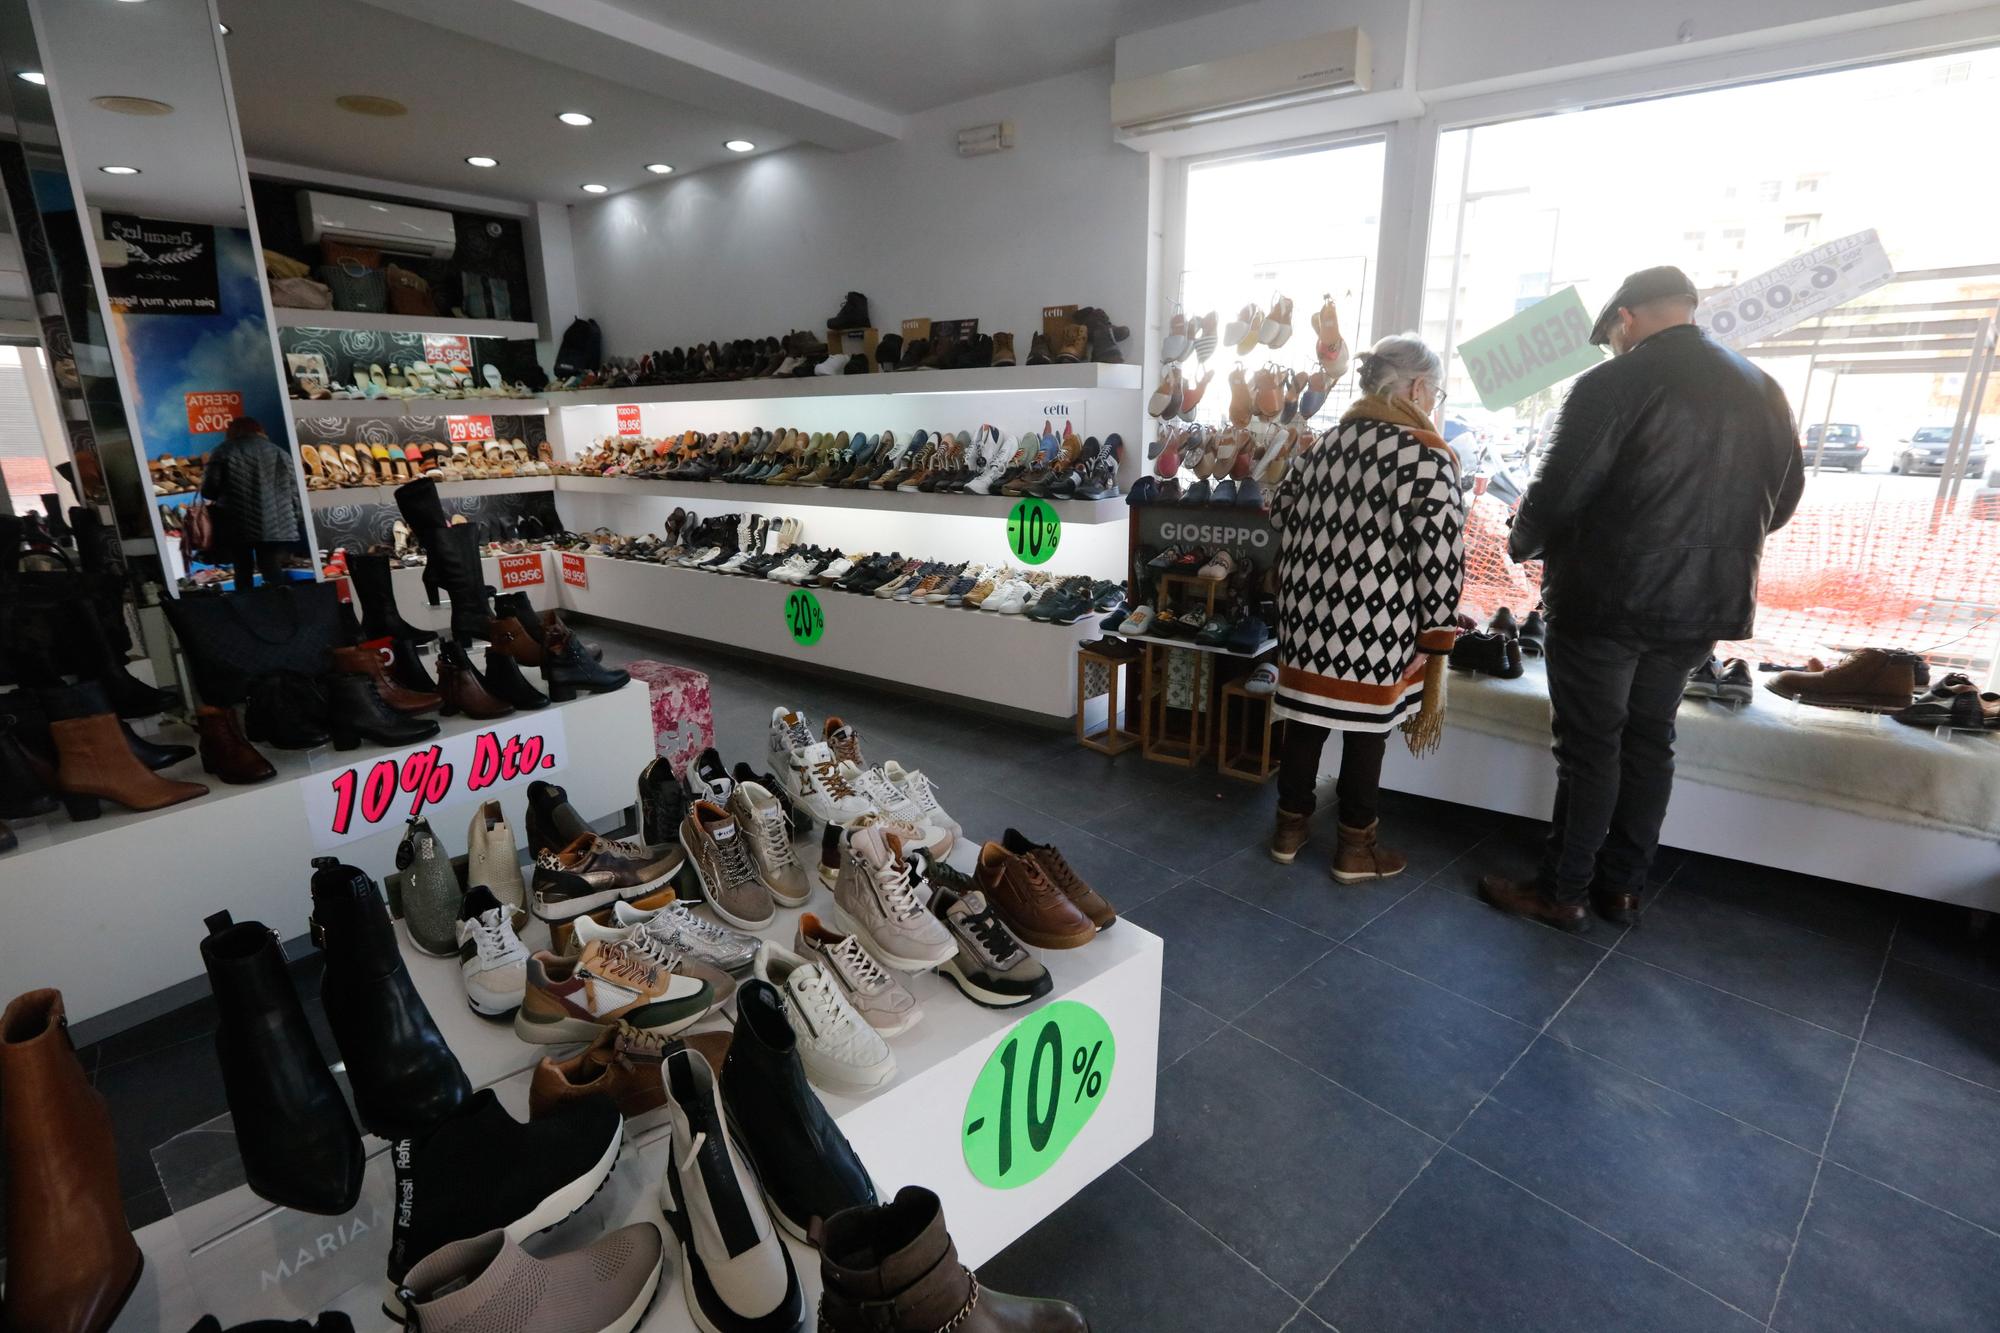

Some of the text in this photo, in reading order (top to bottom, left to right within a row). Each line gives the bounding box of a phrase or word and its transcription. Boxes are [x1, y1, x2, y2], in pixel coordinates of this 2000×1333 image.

[427, 347, 470, 362] 25,95€
[1043, 403, 1070, 416] cetti
[1160, 522, 1269, 548] GIOSEPPO
[502, 558, 525, 568] TODO
[504, 568, 542, 584] 19,95€
[331, 731, 556, 835] 10% Dto.
[398, 1178, 414, 1228] Refresh
